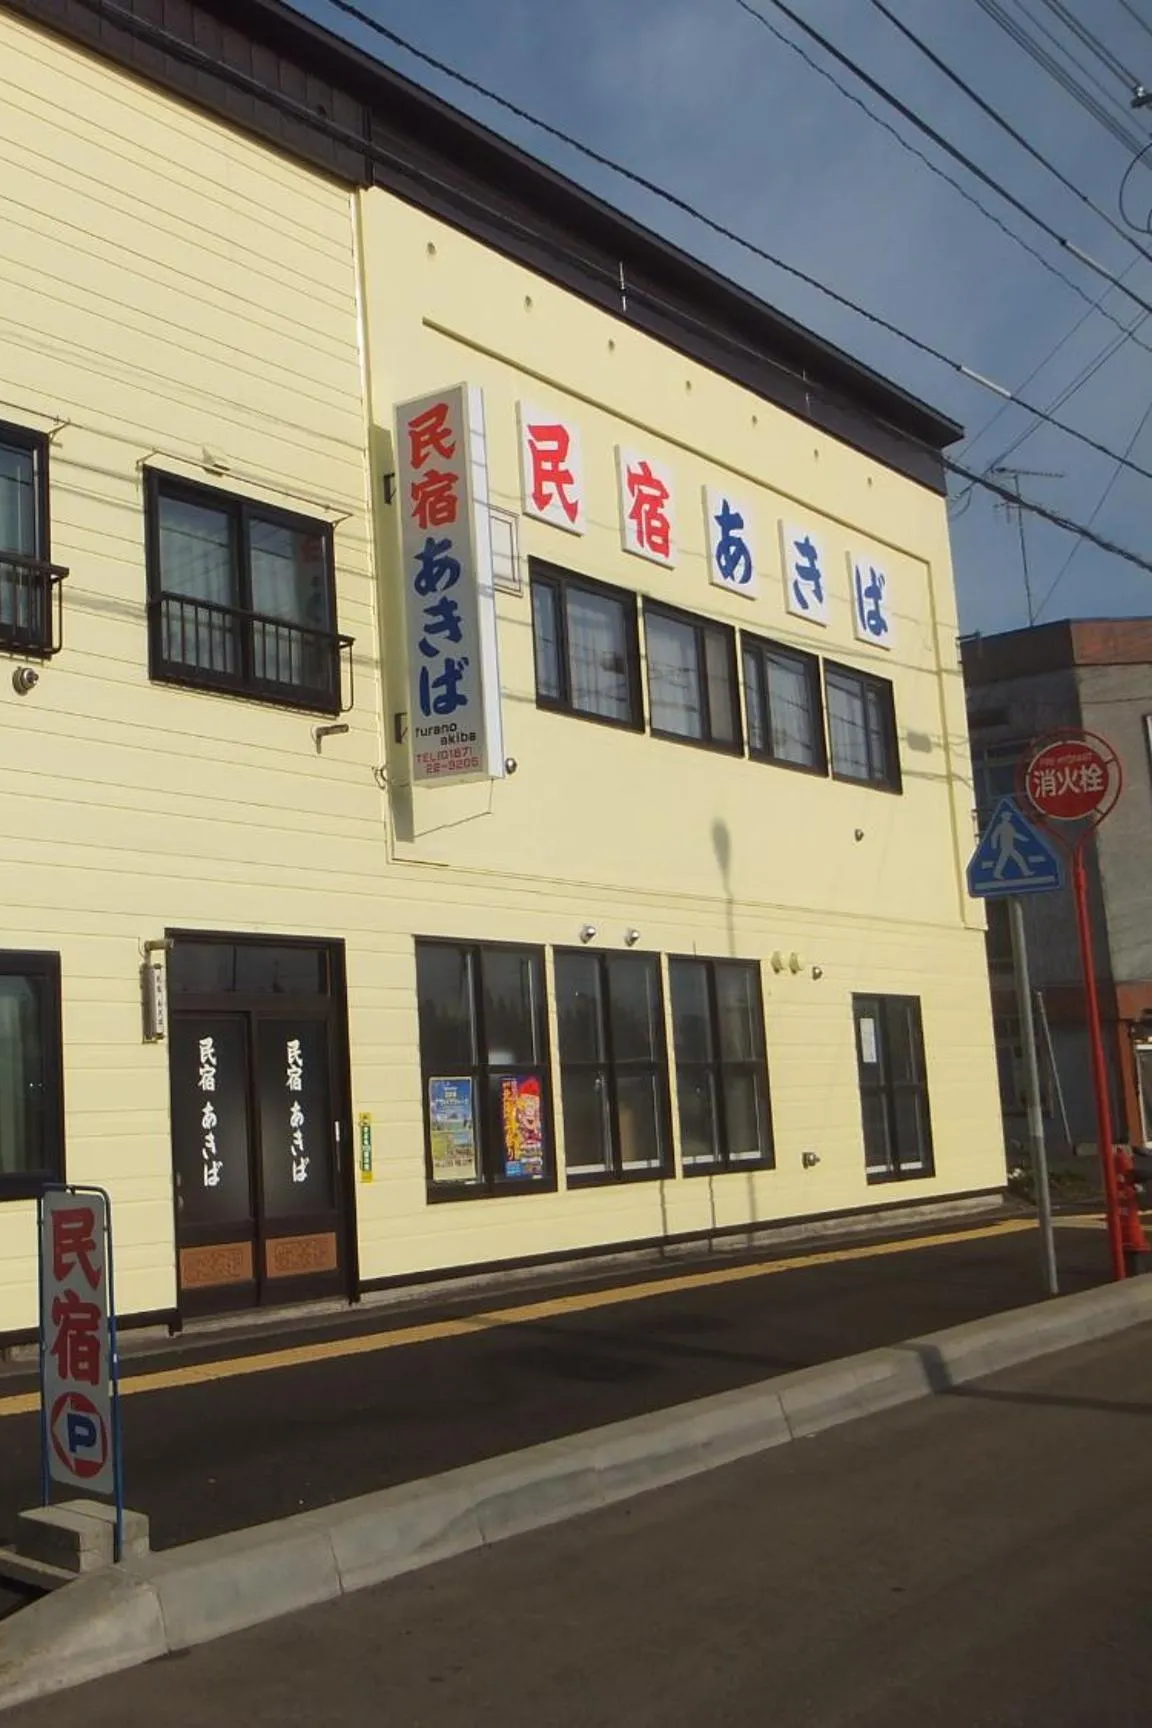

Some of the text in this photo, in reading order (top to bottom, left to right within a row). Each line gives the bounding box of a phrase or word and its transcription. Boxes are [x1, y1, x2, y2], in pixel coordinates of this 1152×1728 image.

[415, 722, 457, 738] furano
[440, 732, 477, 746] akiba
[1033, 763, 1105, 798] 消火栓
[50, 1207, 102, 1386] 民宿
[67, 1413, 97, 1453] P
